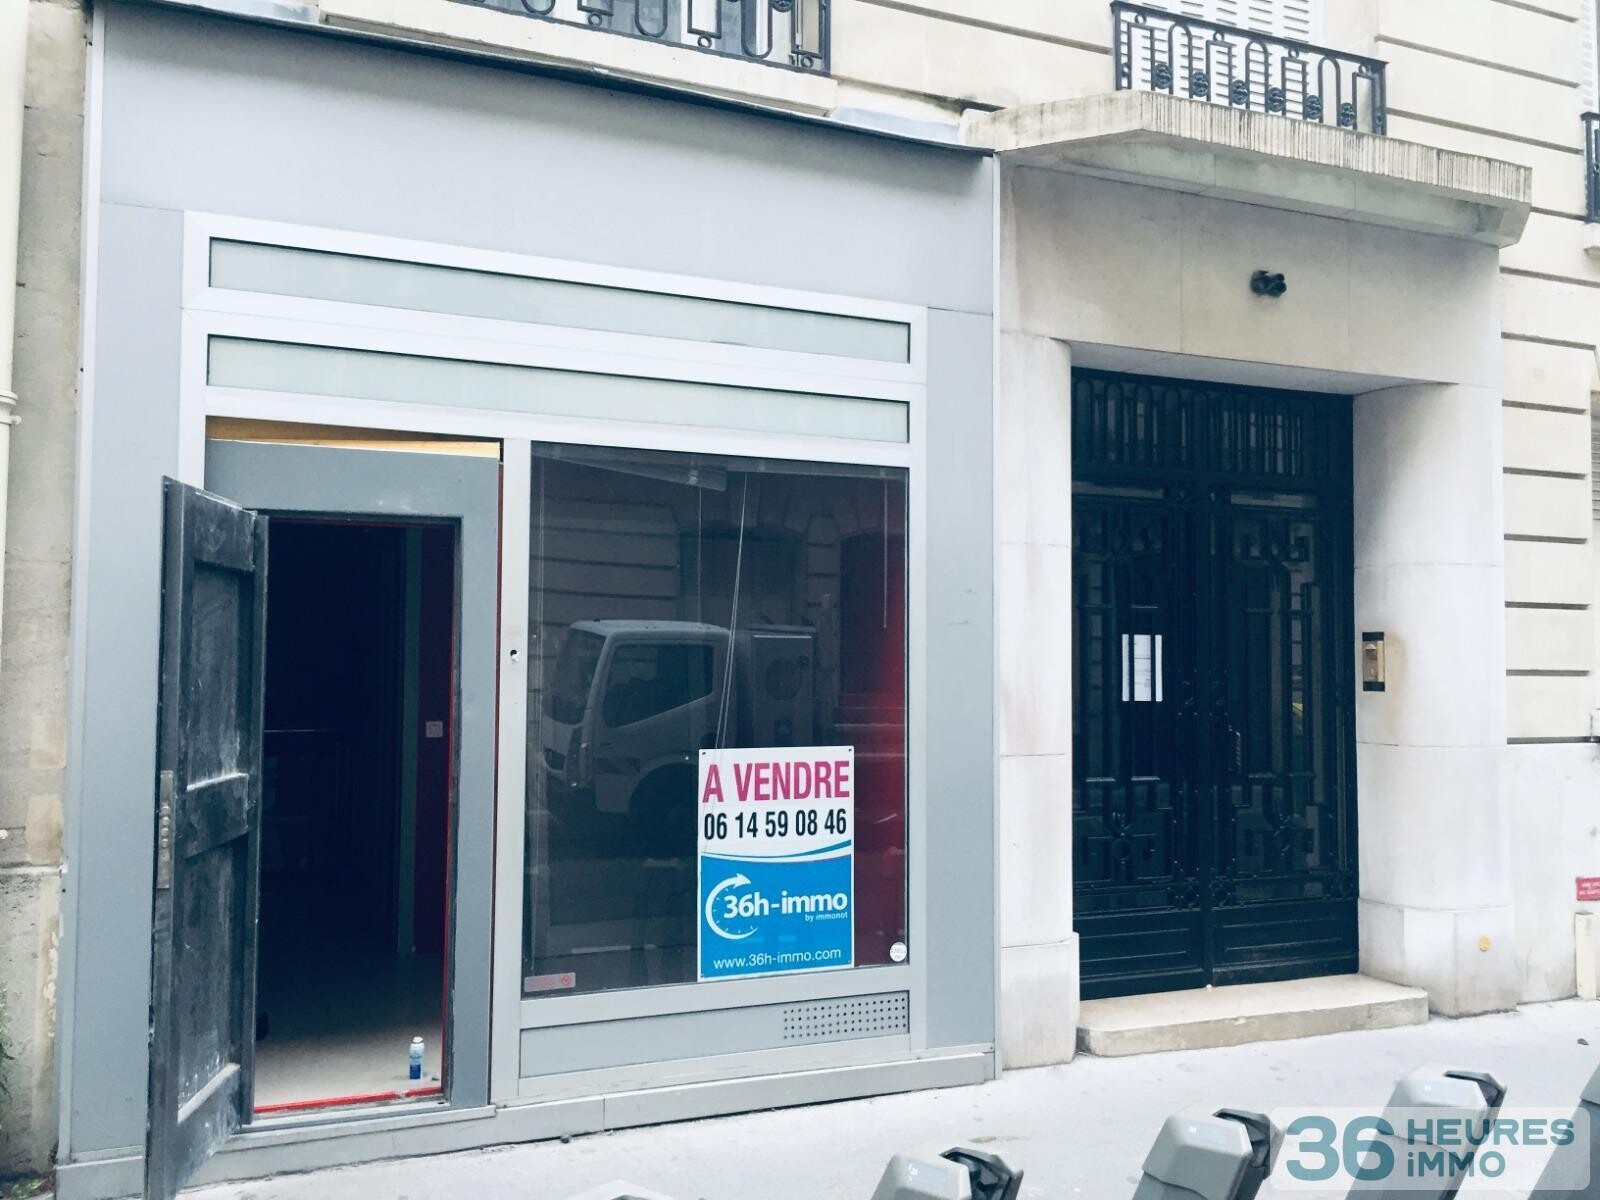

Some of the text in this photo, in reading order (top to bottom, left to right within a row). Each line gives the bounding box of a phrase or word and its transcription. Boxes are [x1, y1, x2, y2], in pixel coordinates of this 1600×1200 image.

[702, 760, 850, 803] A VENDRE
[704, 808, 847, 840] 06 14 59 08 46
[724, 890, 848, 918] 36h-immo
[805, 914, 815, 922] by
[713, 948, 841, 969] www.36h-immo.com
